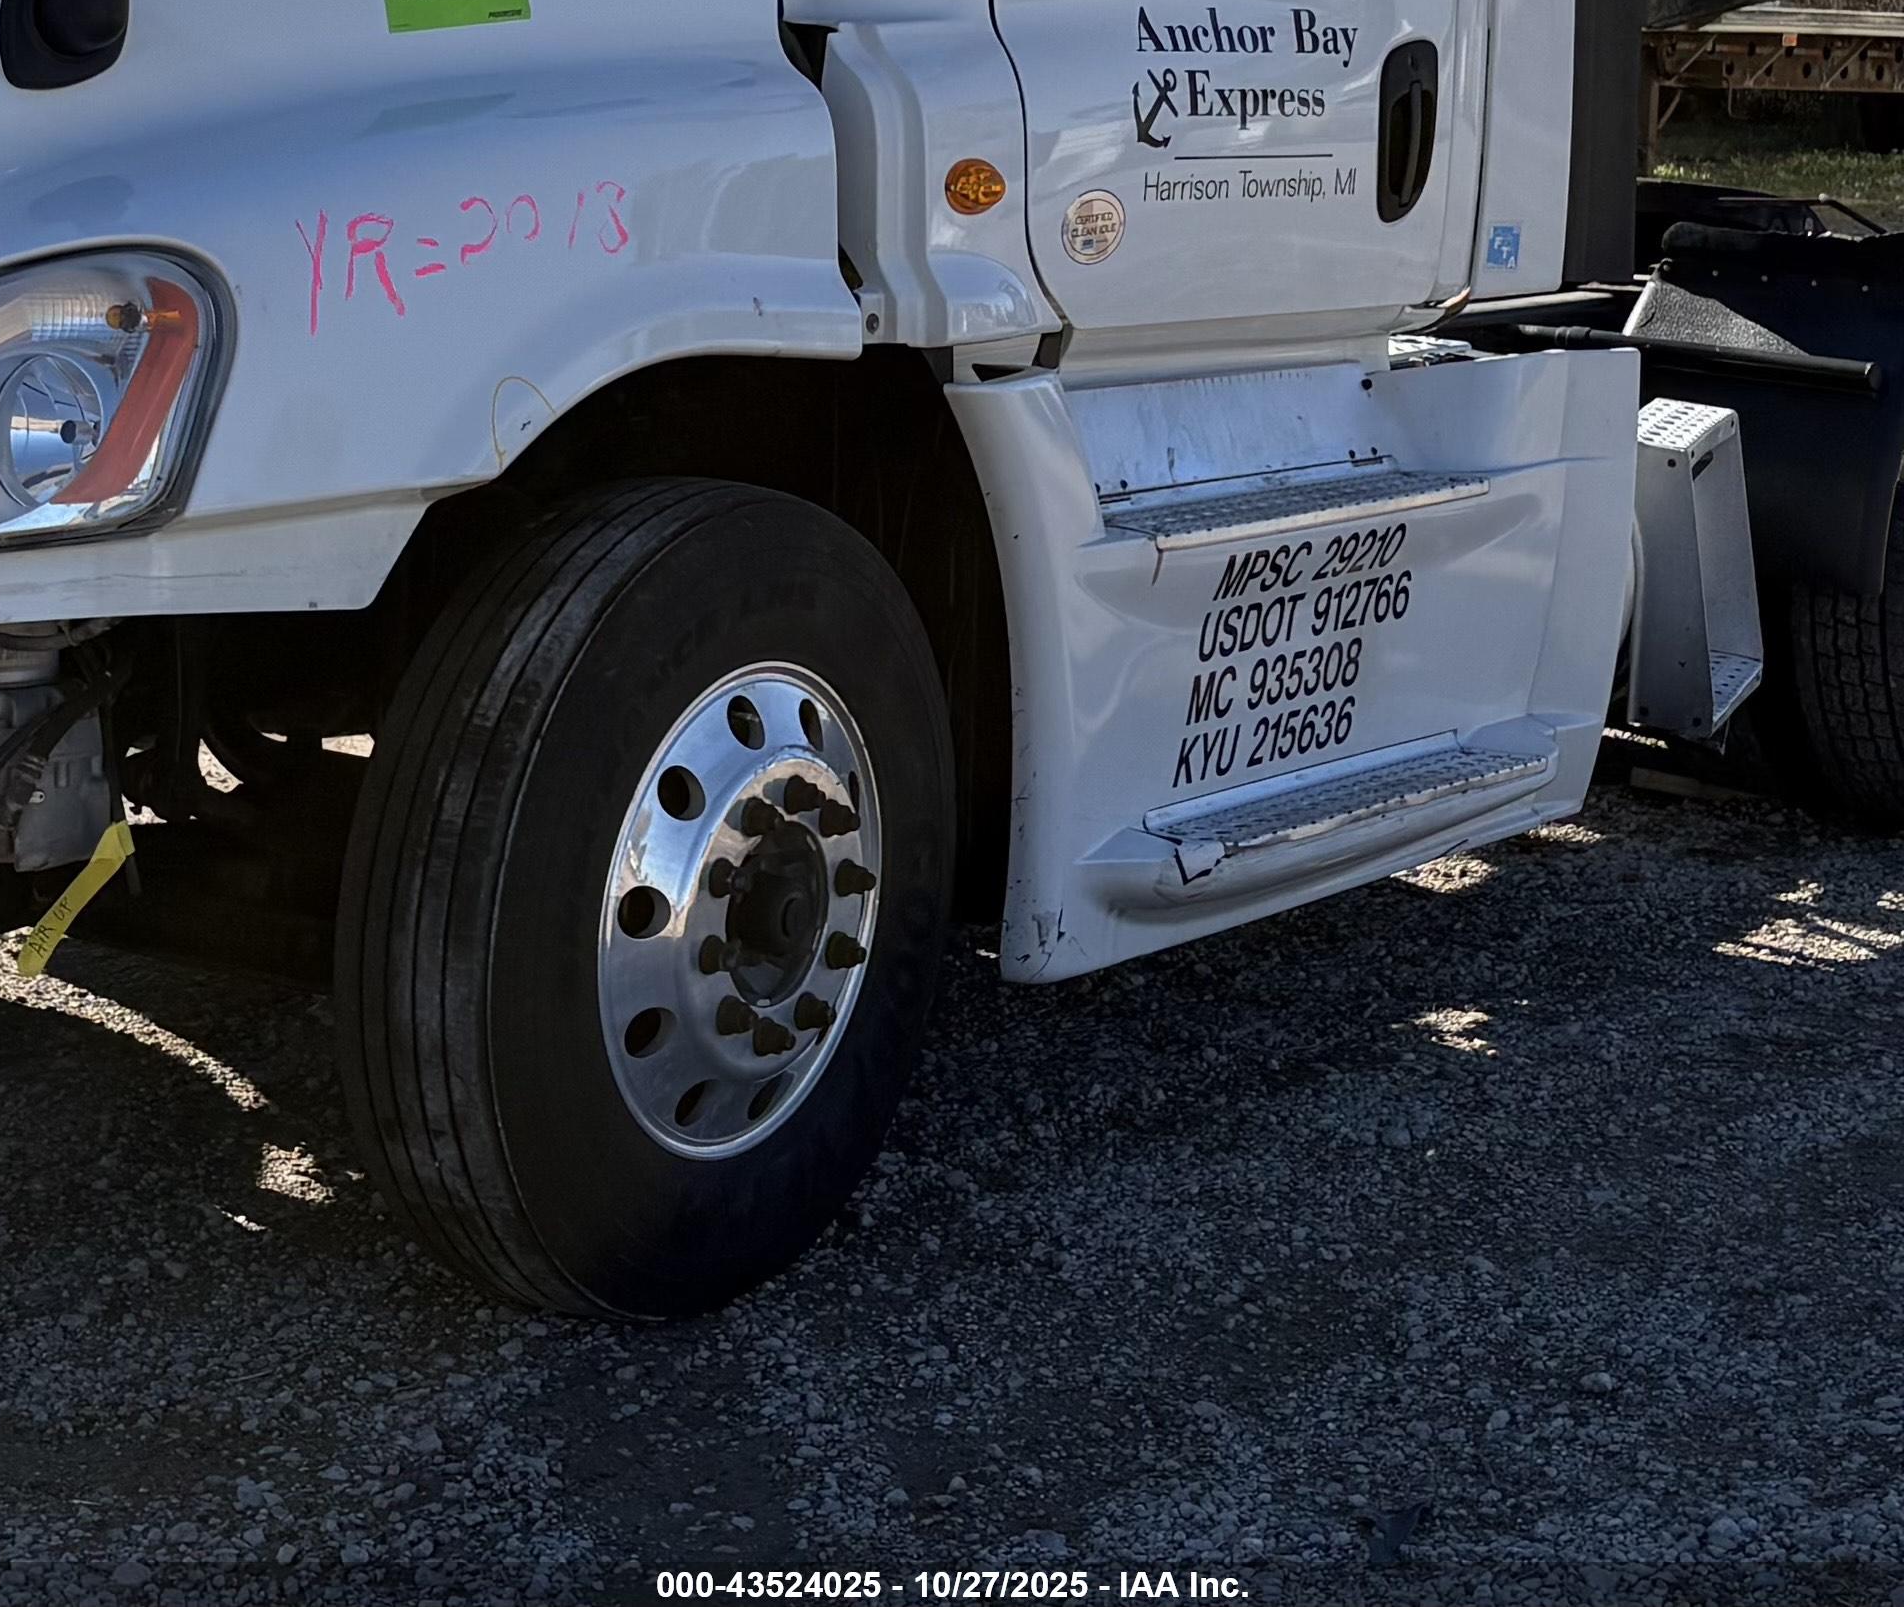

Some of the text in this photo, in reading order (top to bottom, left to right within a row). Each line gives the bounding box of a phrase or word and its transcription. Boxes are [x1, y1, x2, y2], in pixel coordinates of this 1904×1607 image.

[1136, 6, 1359, 68] Anchor Bay
[1184, 69, 1326, 131] Express
[1143, 167, 1357, 203] Harrison Township, MI
[1071, 226, 1098, 238] CLEAN
[1075, 212, 1113, 225] CERTIFIED
[1212, 522, 1407, 601] MPSC 29210
[1199, 570, 1412, 662] USDOT 912766
[1186, 637, 1363, 726] MC 935308
[1172, 695, 1356, 788] KYU 215636
